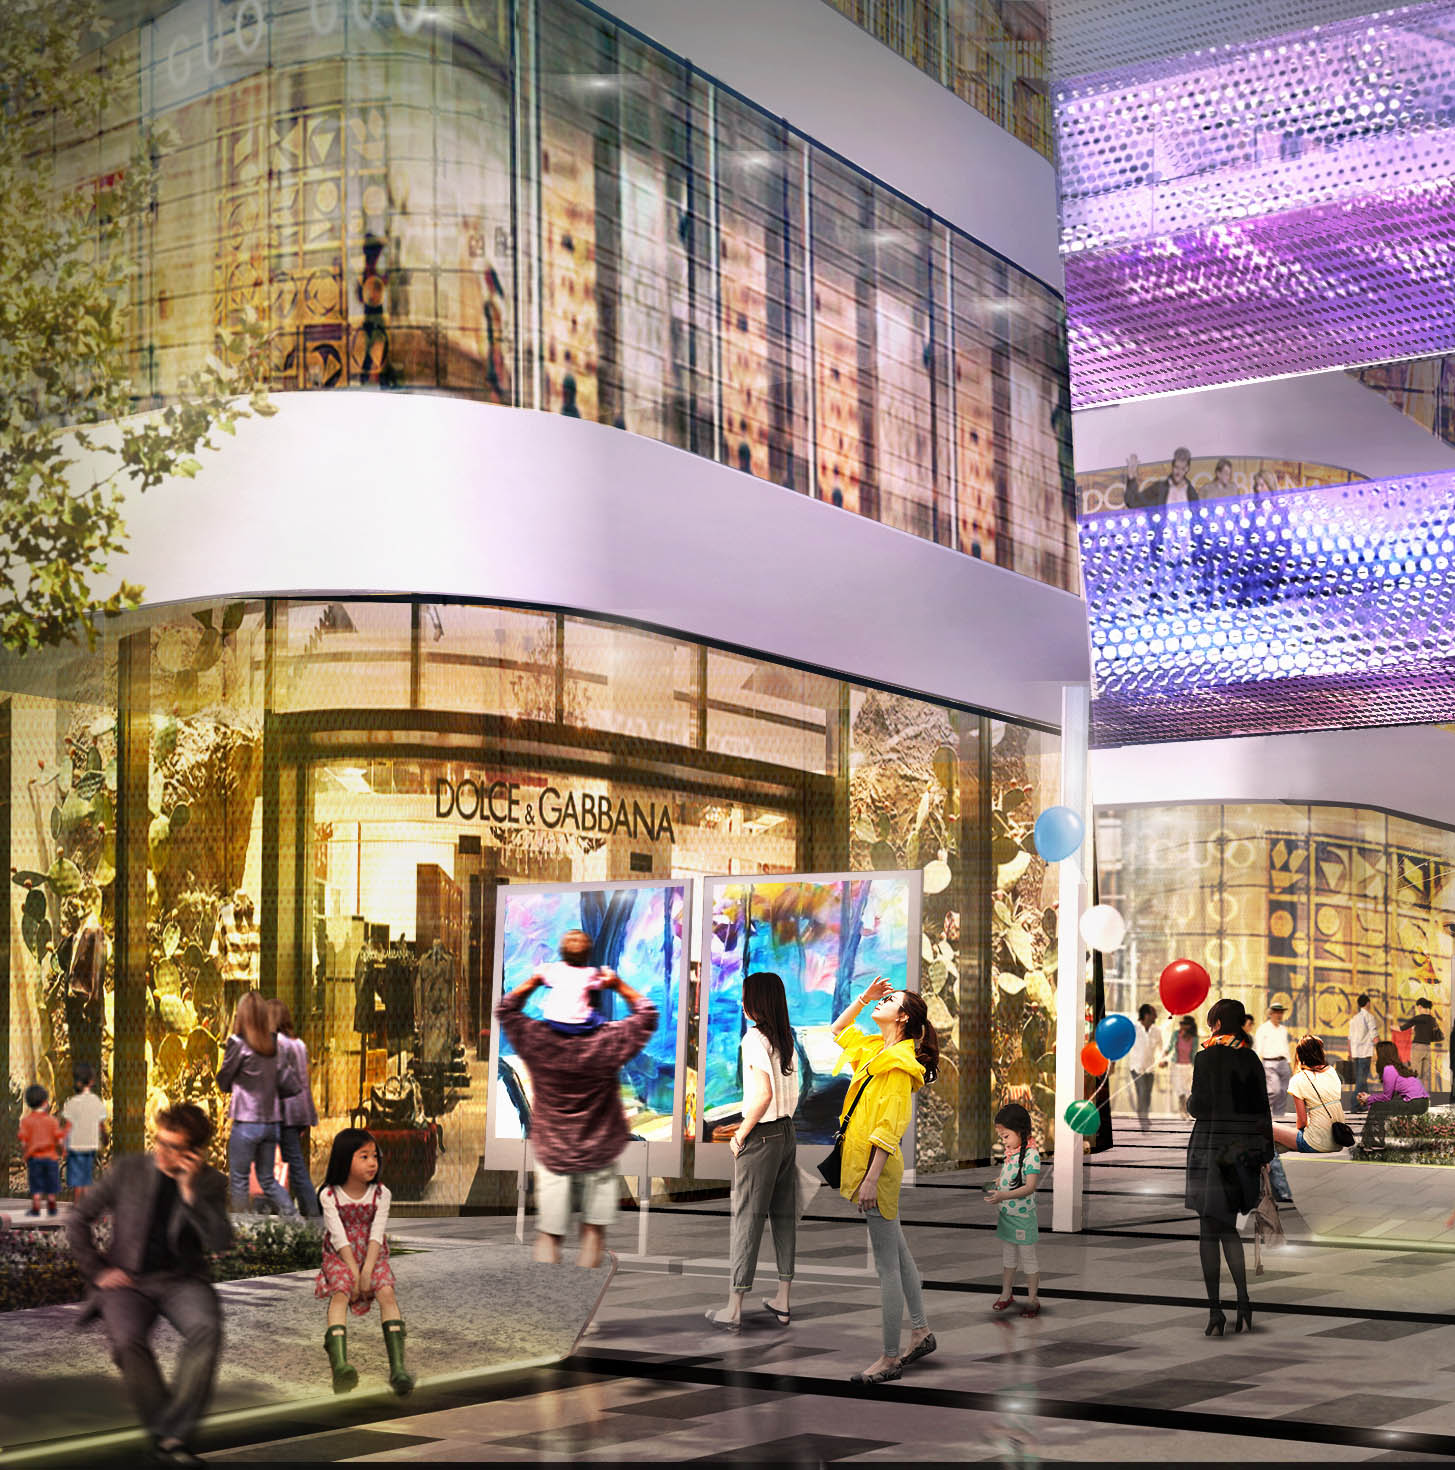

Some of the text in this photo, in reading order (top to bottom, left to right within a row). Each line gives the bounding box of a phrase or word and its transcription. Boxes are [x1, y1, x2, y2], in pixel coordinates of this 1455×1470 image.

[435, 777, 676, 845] DOLCE & GABBANA
